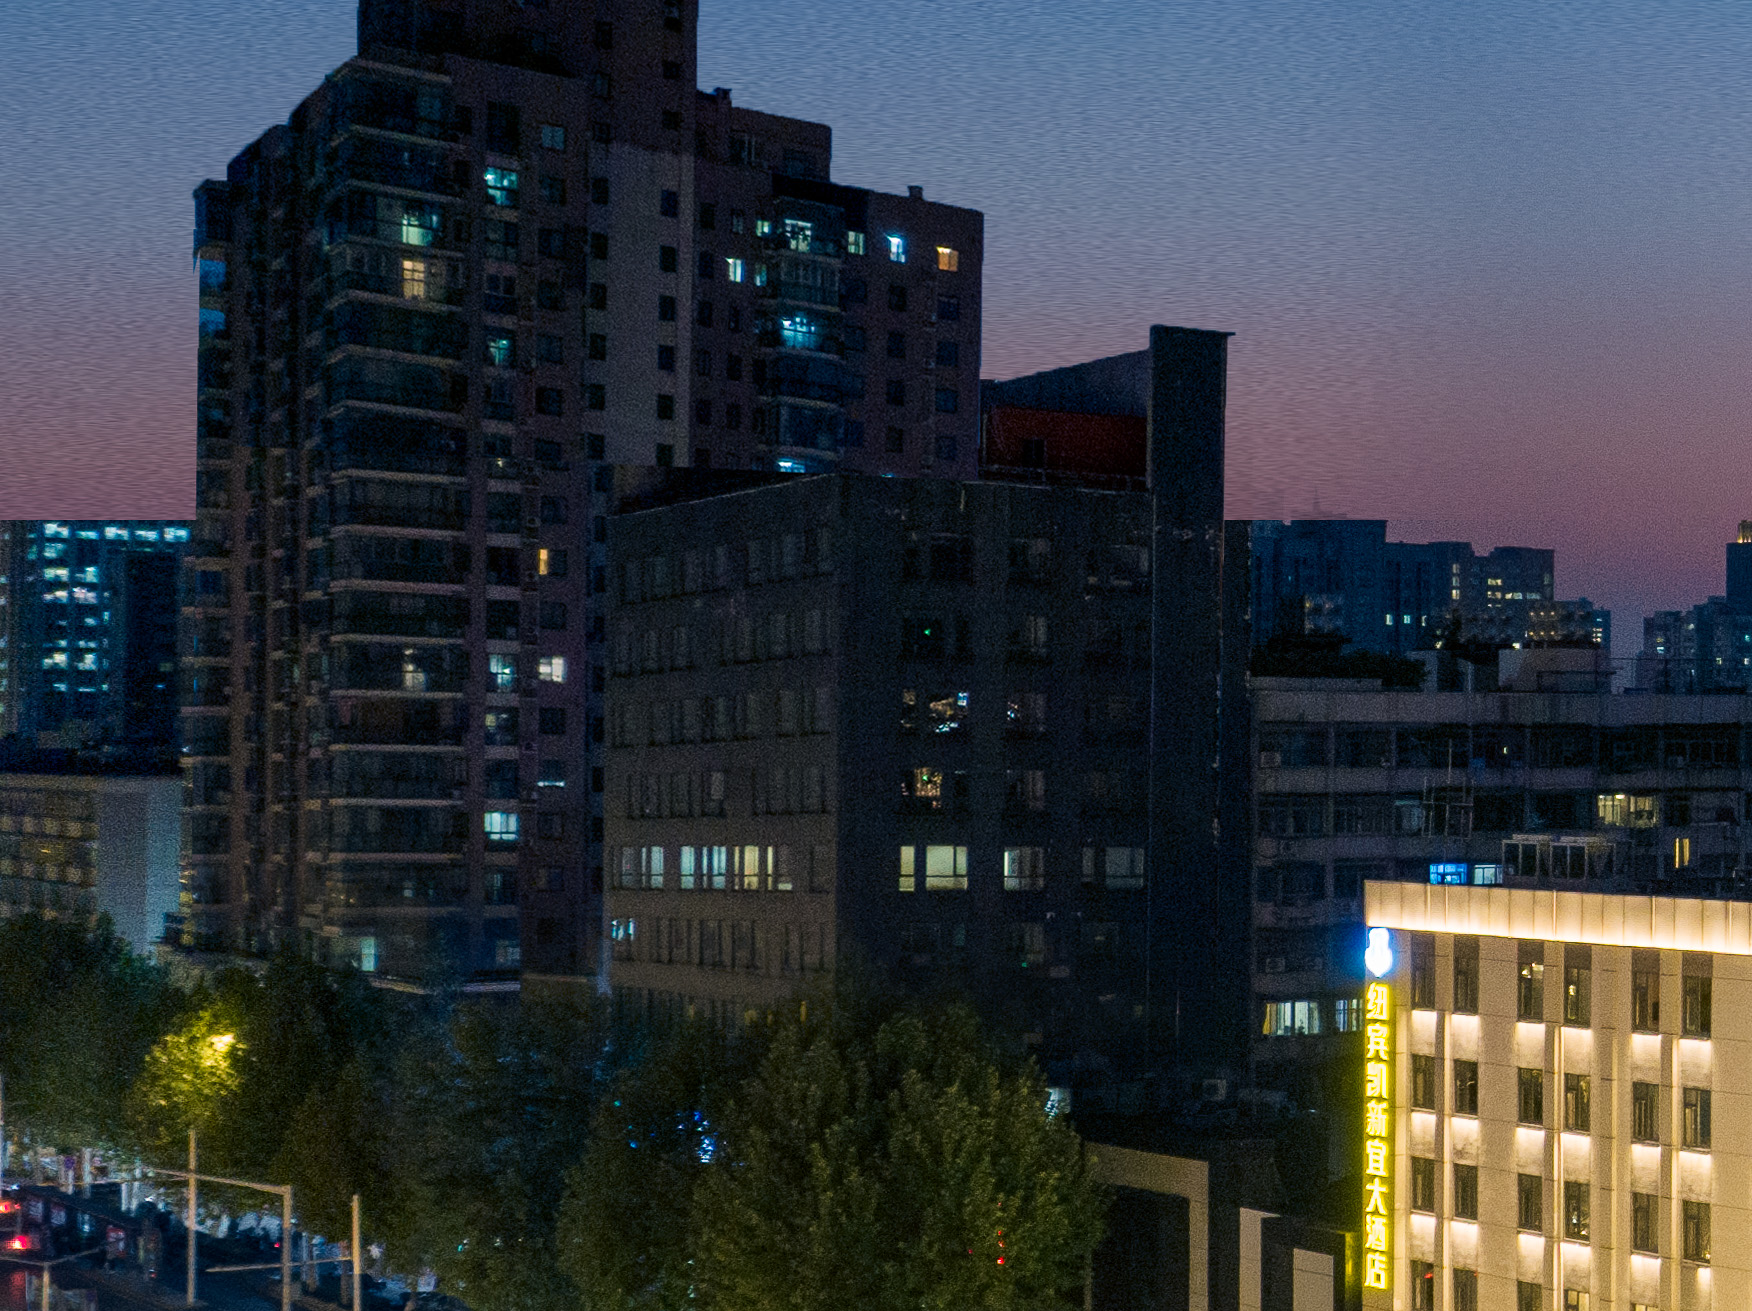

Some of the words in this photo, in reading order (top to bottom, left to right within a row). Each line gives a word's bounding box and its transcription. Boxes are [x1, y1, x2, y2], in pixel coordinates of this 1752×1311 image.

[1364, 981, 1391, 1291] 纽宾凯新宜大酒店
